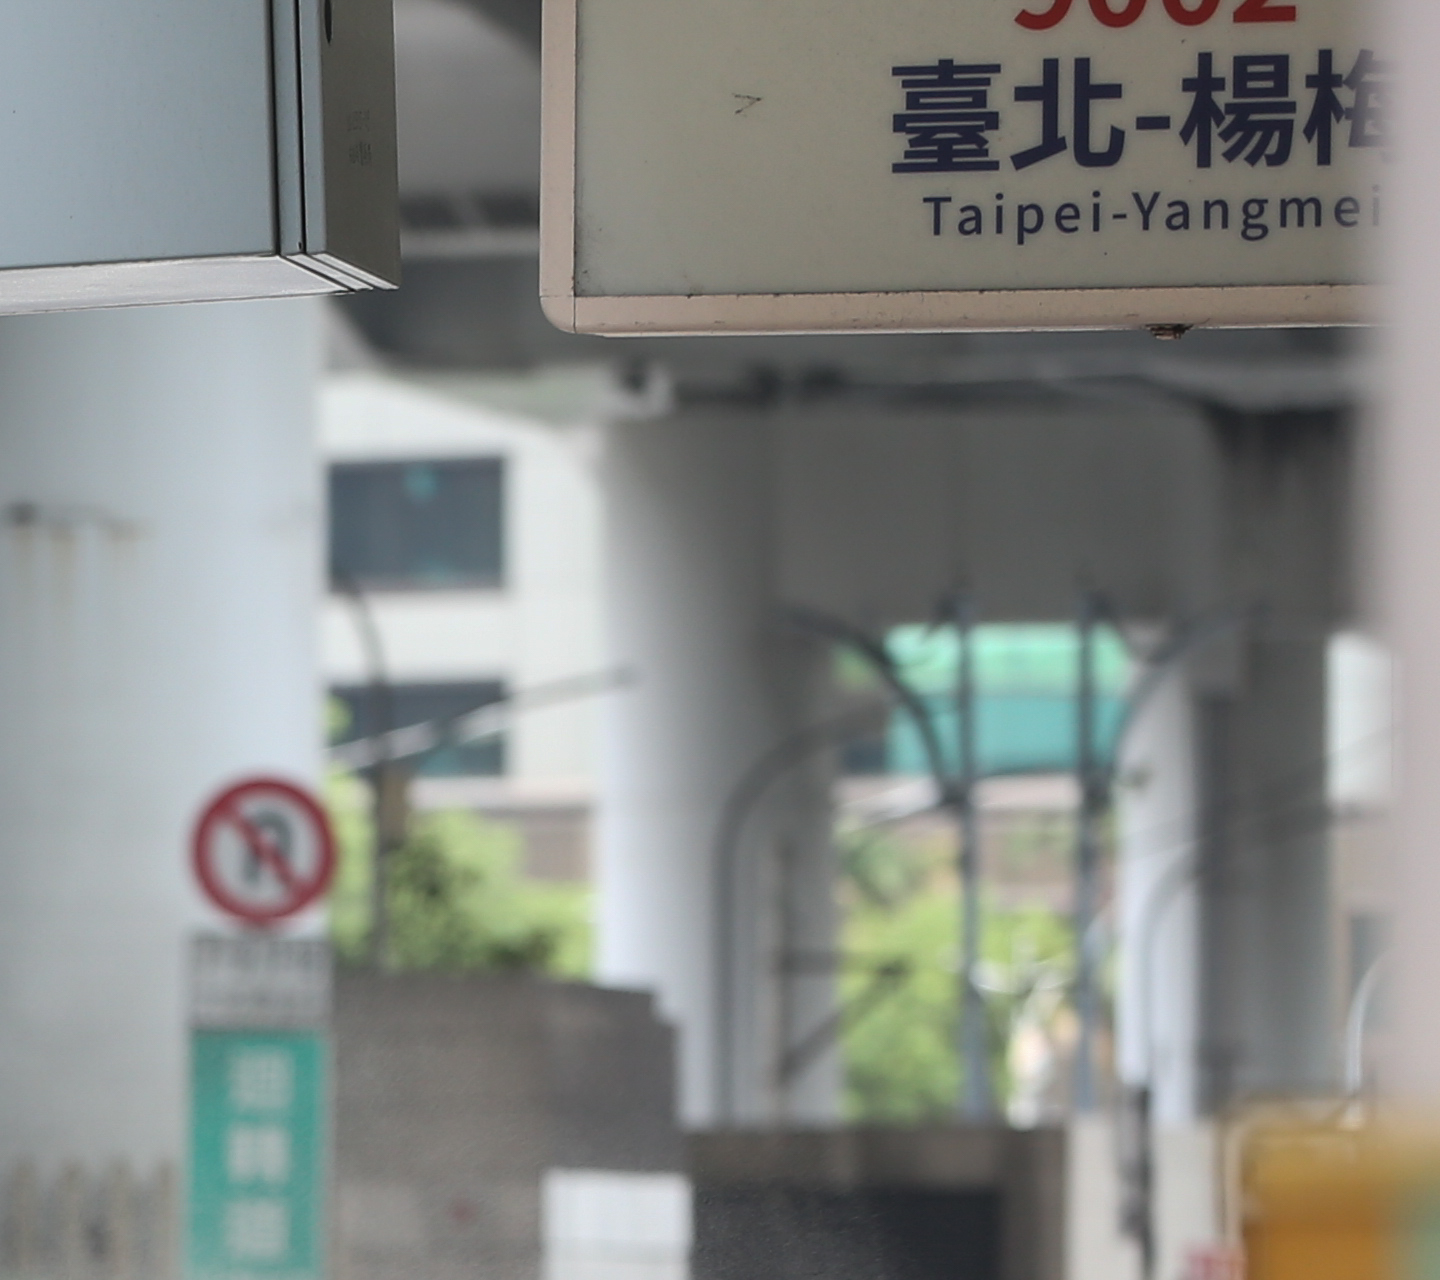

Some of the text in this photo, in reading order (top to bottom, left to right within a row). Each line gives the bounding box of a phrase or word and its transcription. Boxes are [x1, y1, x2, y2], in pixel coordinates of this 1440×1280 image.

[892, 49, 1396, 174] 臺北-楊梅
[922, 185, 1380, 246] Taipei-Yangmei
